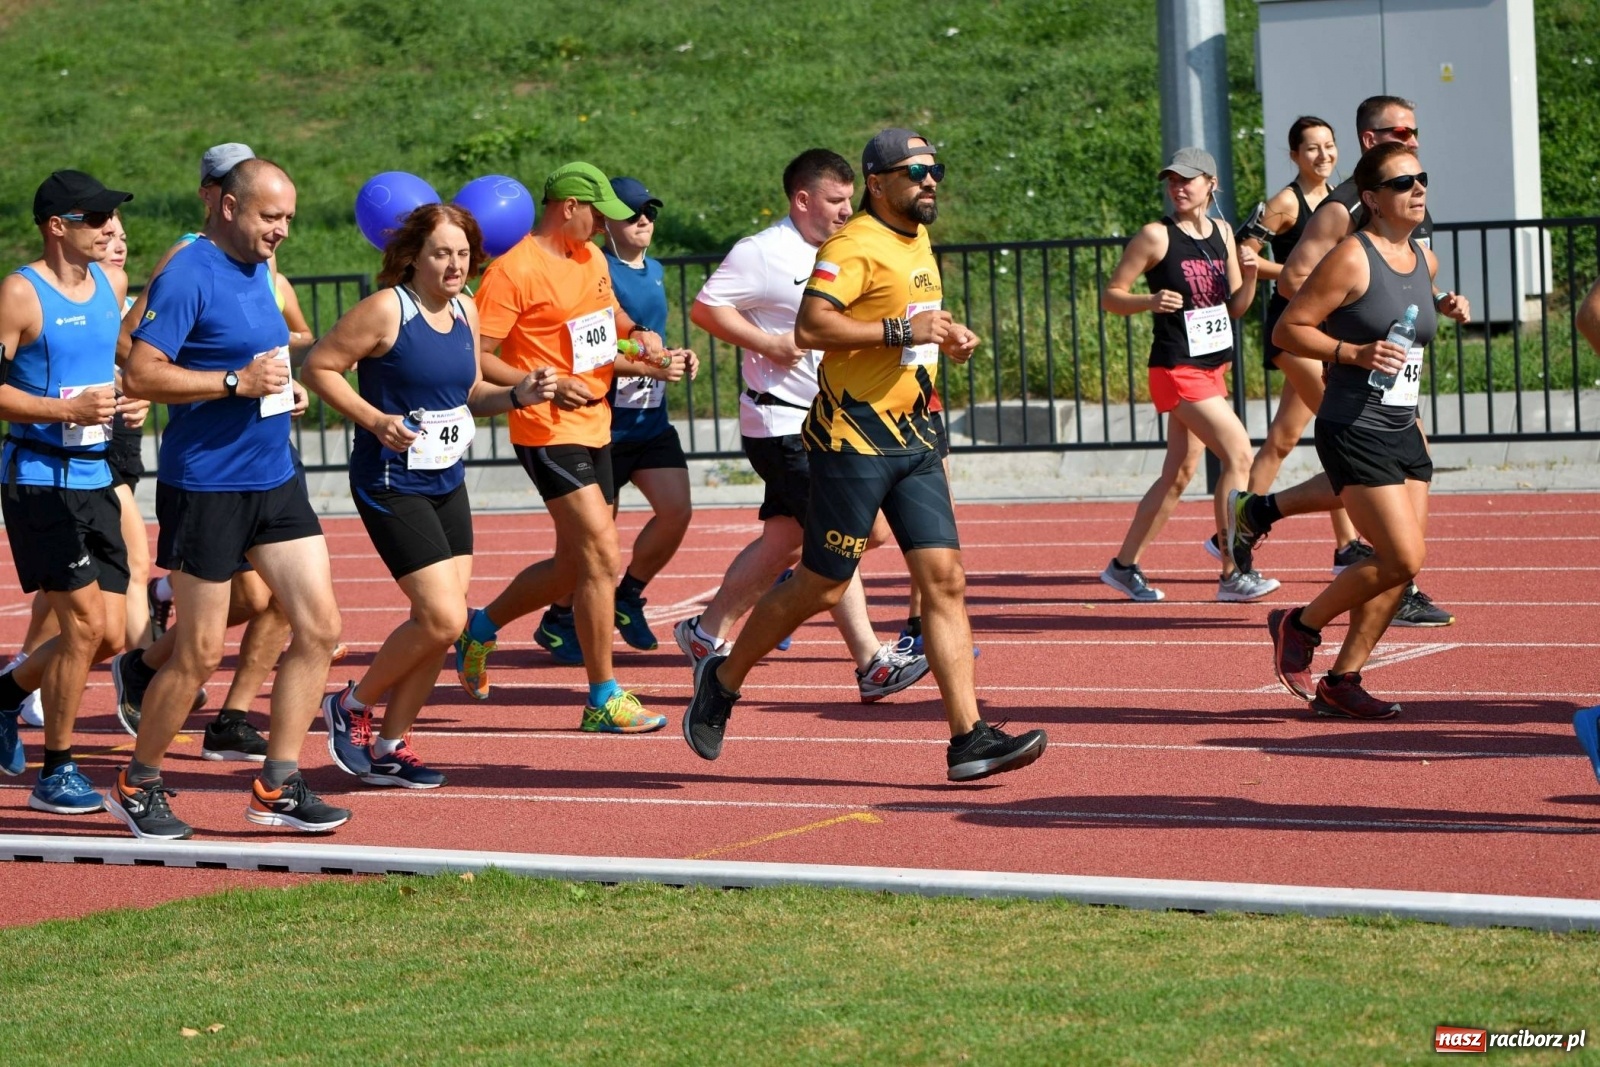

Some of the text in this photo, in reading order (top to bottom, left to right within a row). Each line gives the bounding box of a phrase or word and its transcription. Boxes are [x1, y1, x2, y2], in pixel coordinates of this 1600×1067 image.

[914, 273, 932, 289] OPEL
[1206, 316, 1227, 335] 323
[586, 325, 607, 347] 408
[439, 424, 459, 445] 48
[823, 542, 851, 558] ACTIVE
